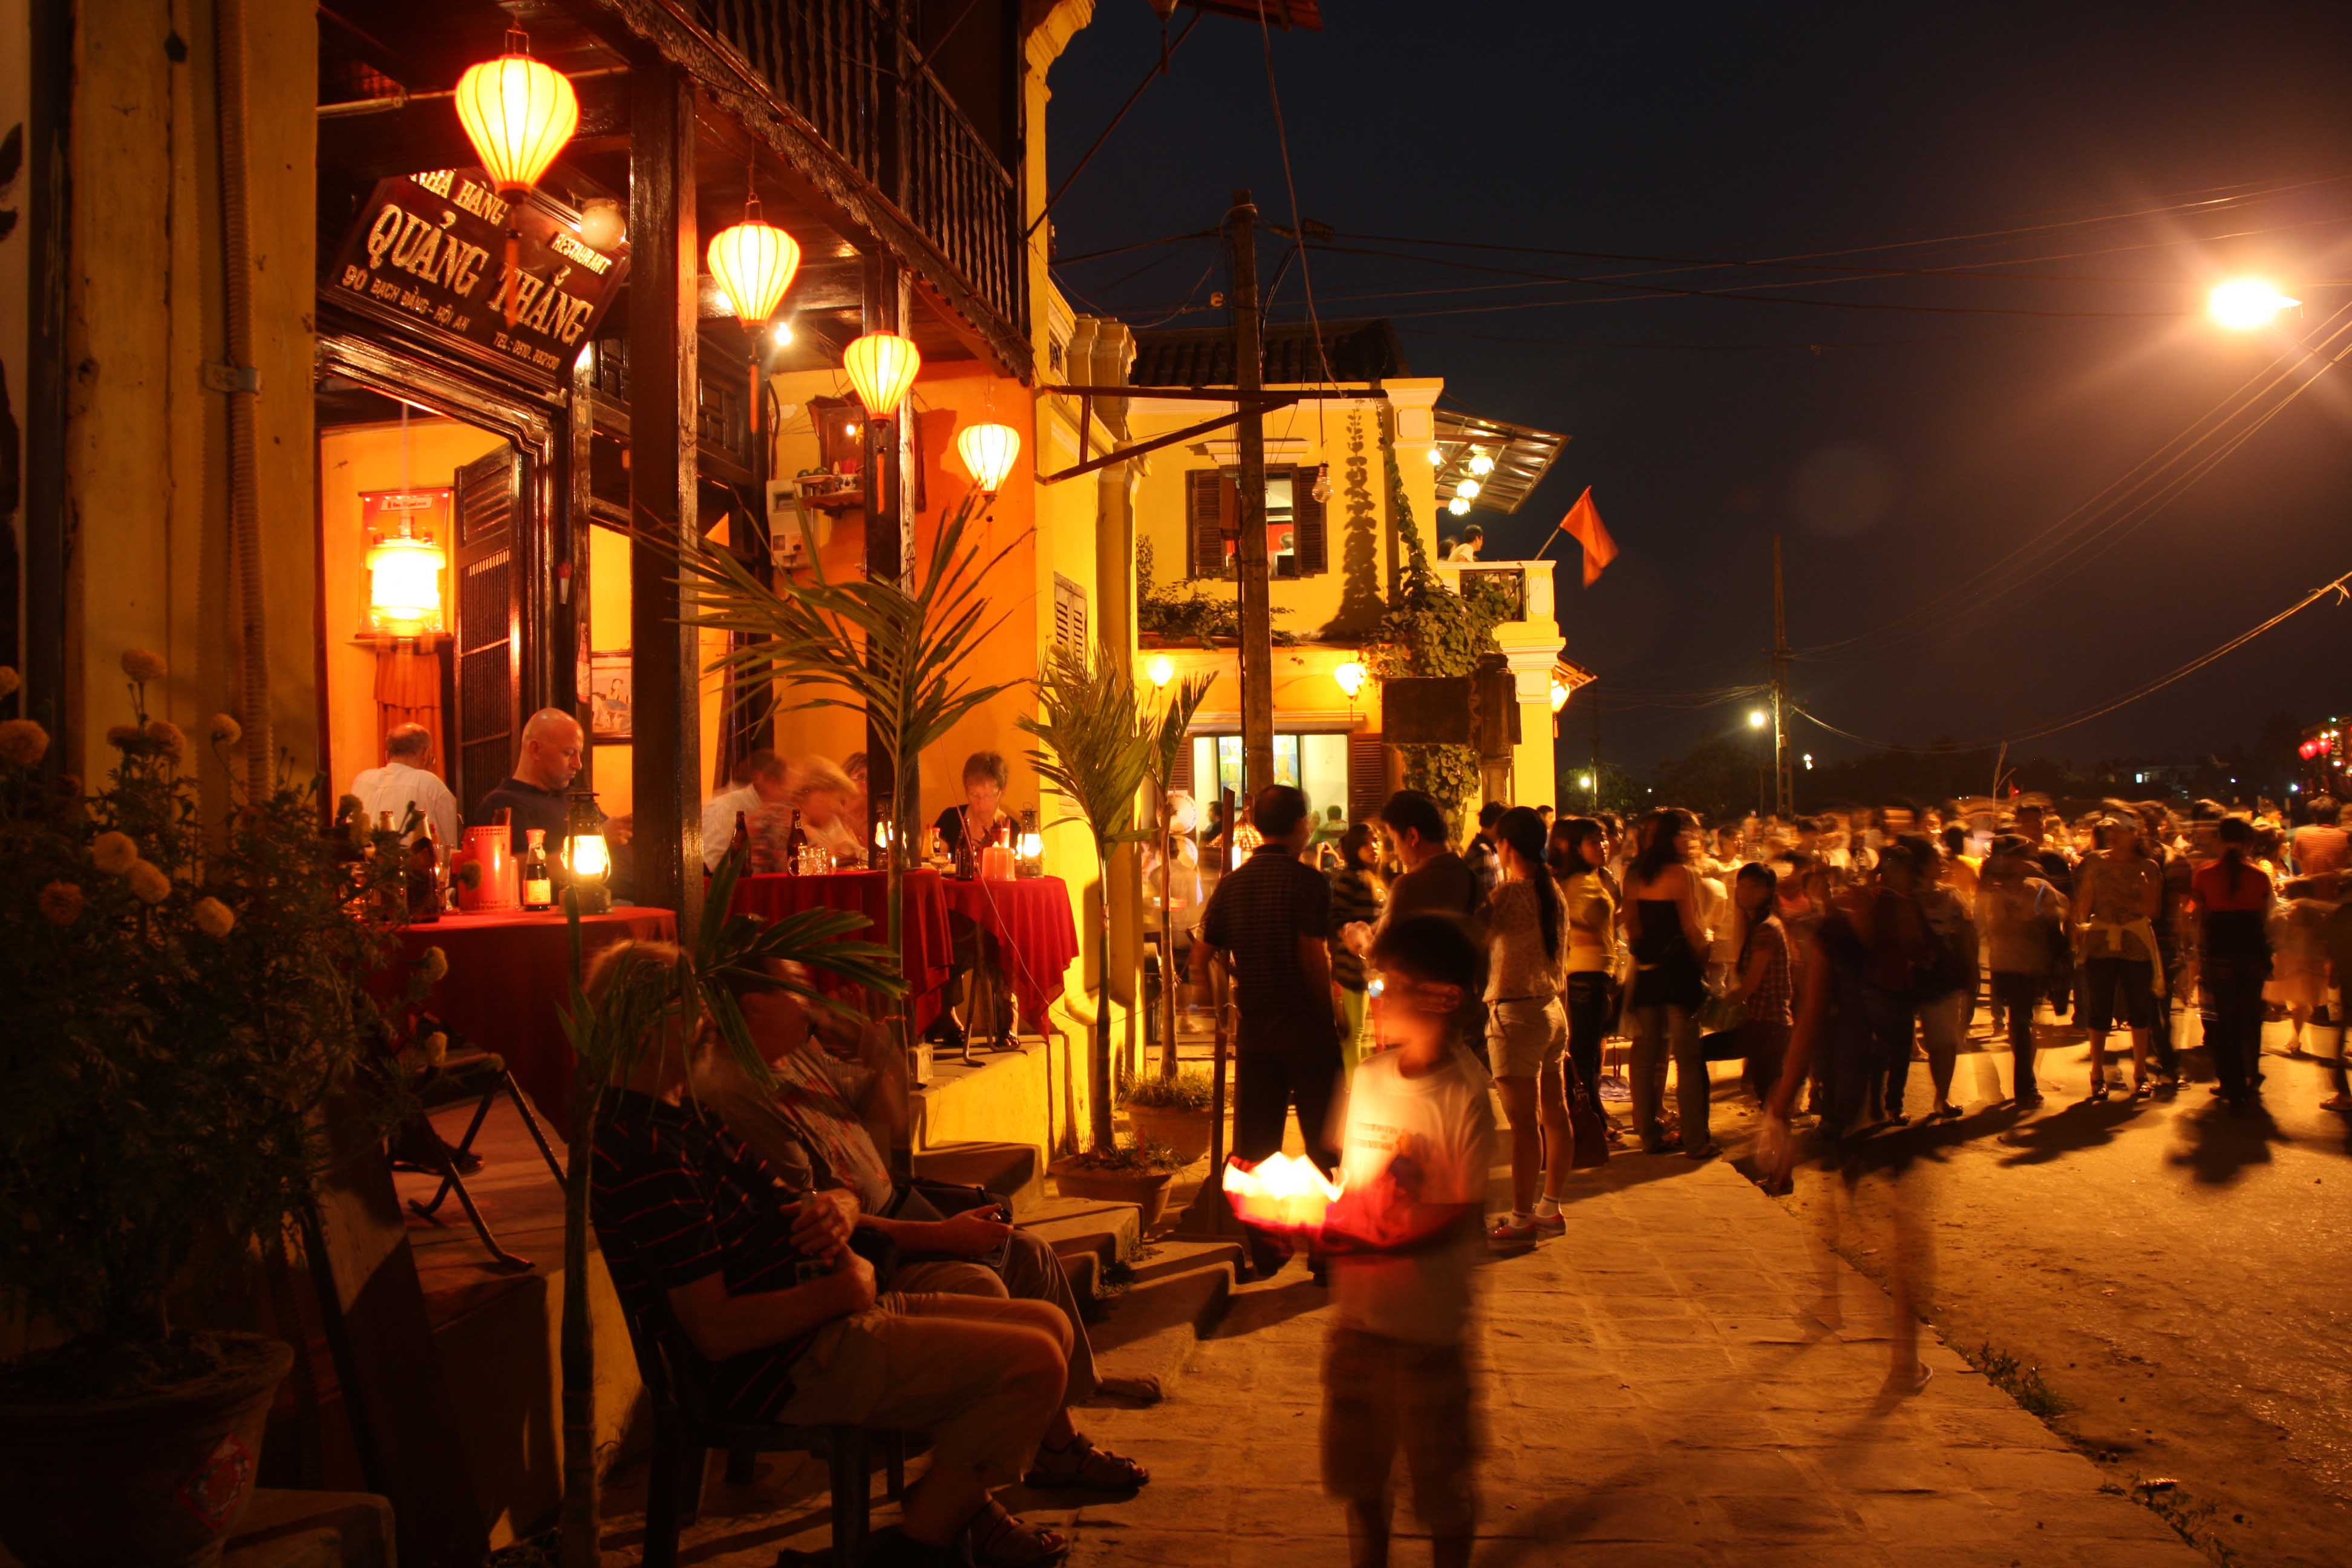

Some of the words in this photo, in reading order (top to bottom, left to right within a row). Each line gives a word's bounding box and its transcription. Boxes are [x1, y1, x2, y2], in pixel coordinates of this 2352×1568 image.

[452, 178, 511, 227] HÀNG
[367, 204, 489, 298] QUẢNG
[551, 234, 612, 275] RESTAURANT
[342, 265, 367, 290] 90
[370, 277, 401, 301] BẠCH
[452, 315, 470, 332] AN
